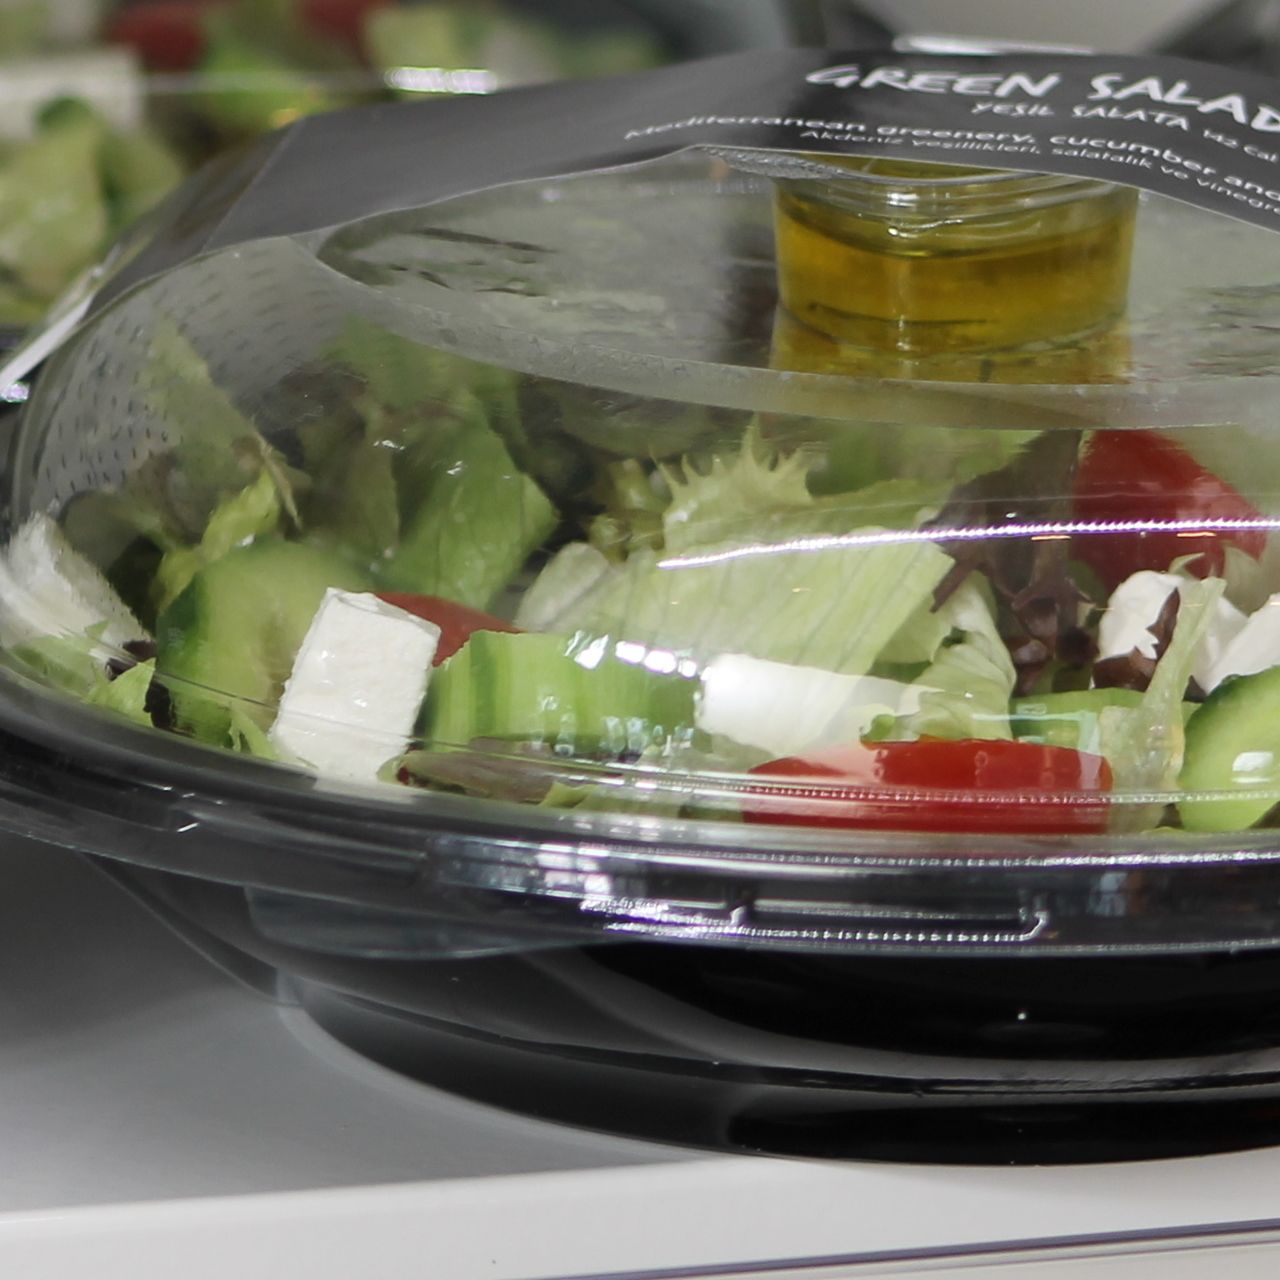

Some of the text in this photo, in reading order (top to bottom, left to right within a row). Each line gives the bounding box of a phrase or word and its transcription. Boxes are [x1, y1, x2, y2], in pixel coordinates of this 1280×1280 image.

[805, 64, 1062, 97] GREEN
[1072, 105, 1190, 131] SALATA
[1202, 128, 1239, 150] 142
[1242, 144, 1279, 164] Cal
[1049, 135, 1216, 176] cucumber
[1160, 165, 1190, 181] ve
